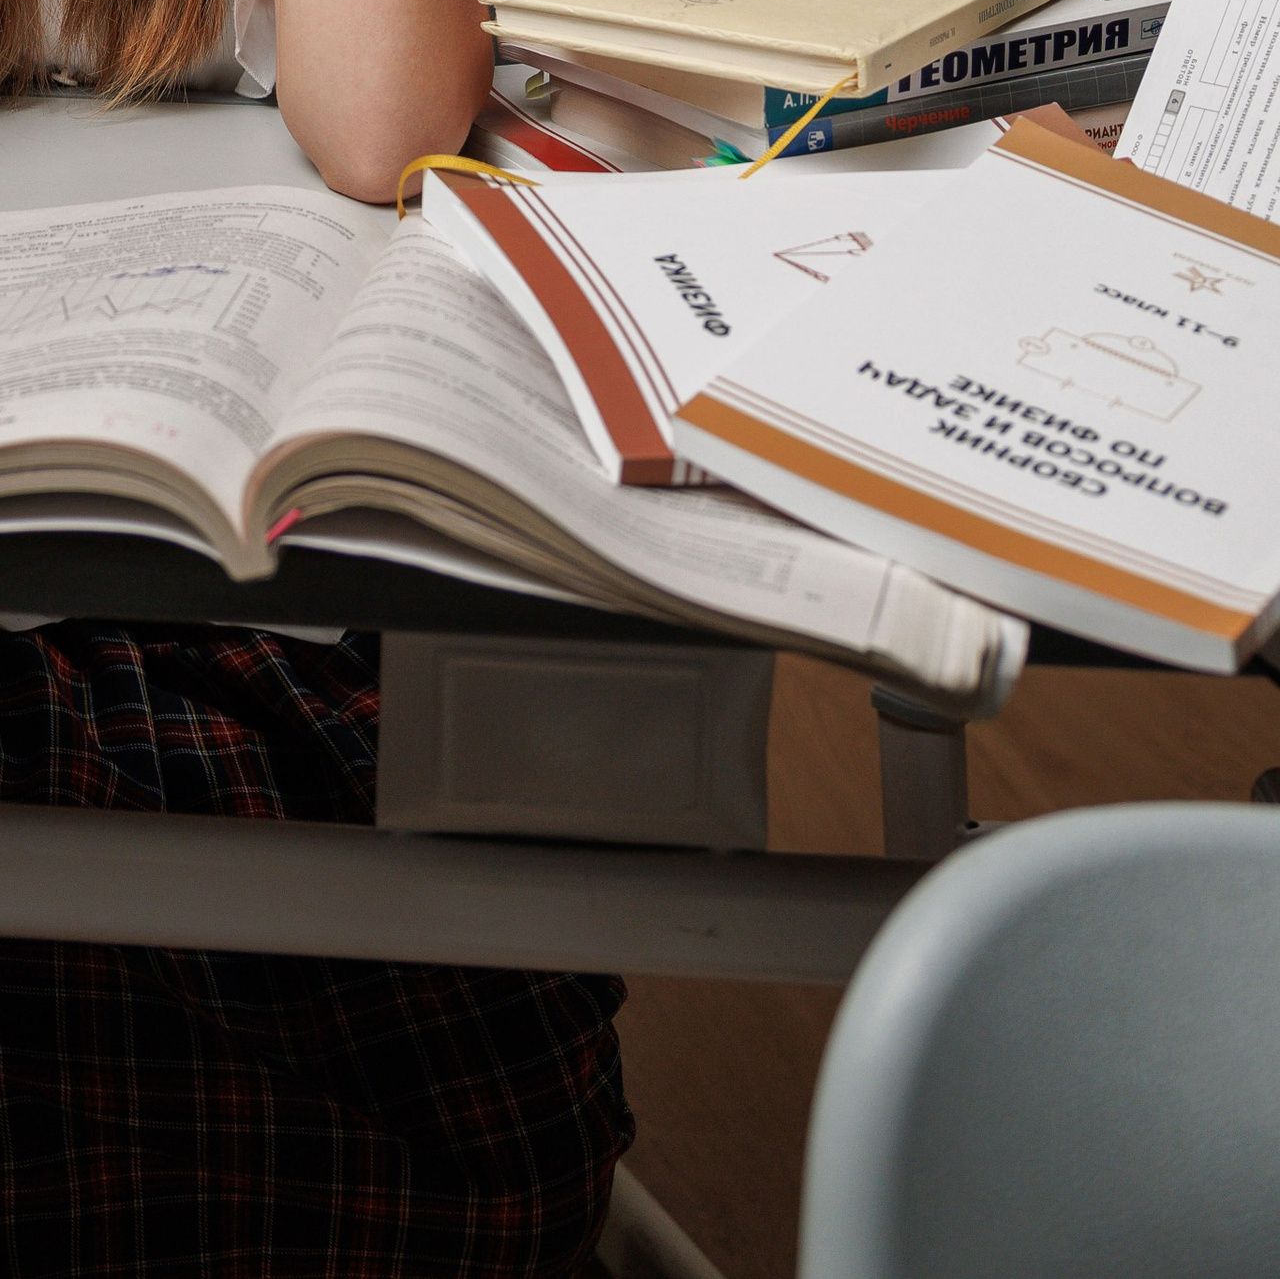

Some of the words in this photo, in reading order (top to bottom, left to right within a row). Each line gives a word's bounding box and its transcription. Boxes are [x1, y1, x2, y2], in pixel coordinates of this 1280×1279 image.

[1235, 21, 1249, 45] факт
[1250, 16, 1267, 47] Номер
[1176, 49, 1193, 85] ОТВЕТОВ
[1183, 58, 1198, 86] БЛАНК
[1255, 31, 1279, 81] политика
[1222, 47, 1252, 119] предложения,
[885, 105, 971, 133] Черчение
[1219, 84, 1258, 174] протекционизма.
[1247, 119, 1265, 155] власти
[1189, 141, 1203, 167] тезис
[1195, 119, 1224, 188] содержащего
[654, 253, 731, 337] ФИЗИКА
[1093, 283, 1169, 319] класс
[856, 360, 980, 421] ЗАДАЧ
[947, 374, 1101, 443] ФИЗИКЕ
[984, 415, 1015, 435] И
[929, 418, 1109, 498] СБОРНИК
[1109, 439, 1168, 469] ПО
[1021, 430, 1229, 517] ВОПРОСОВ
